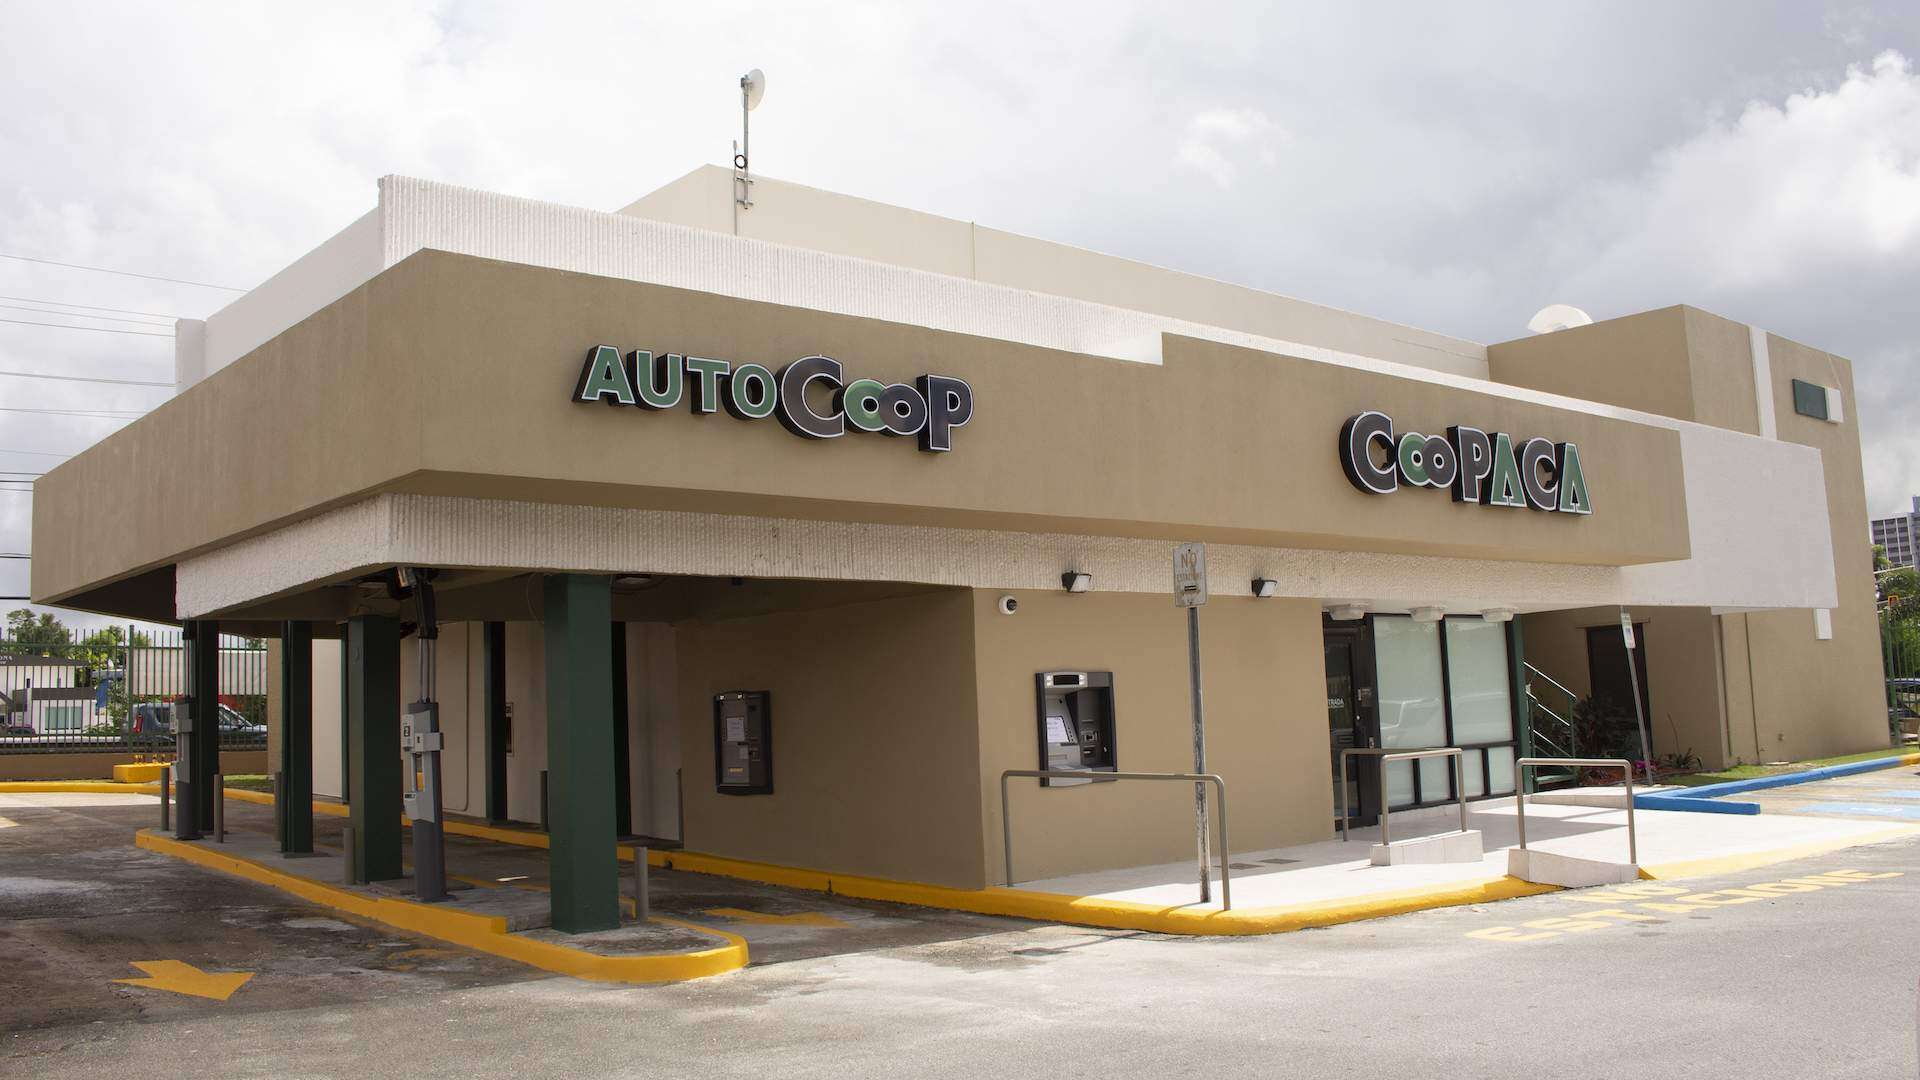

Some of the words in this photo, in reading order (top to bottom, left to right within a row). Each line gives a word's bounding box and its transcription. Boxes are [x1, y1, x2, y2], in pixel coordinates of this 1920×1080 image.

[1181, 552, 1198, 568] NO
[1560, 885, 1690, 902] NO
[1464, 869, 1905, 942] ESTACIONE
